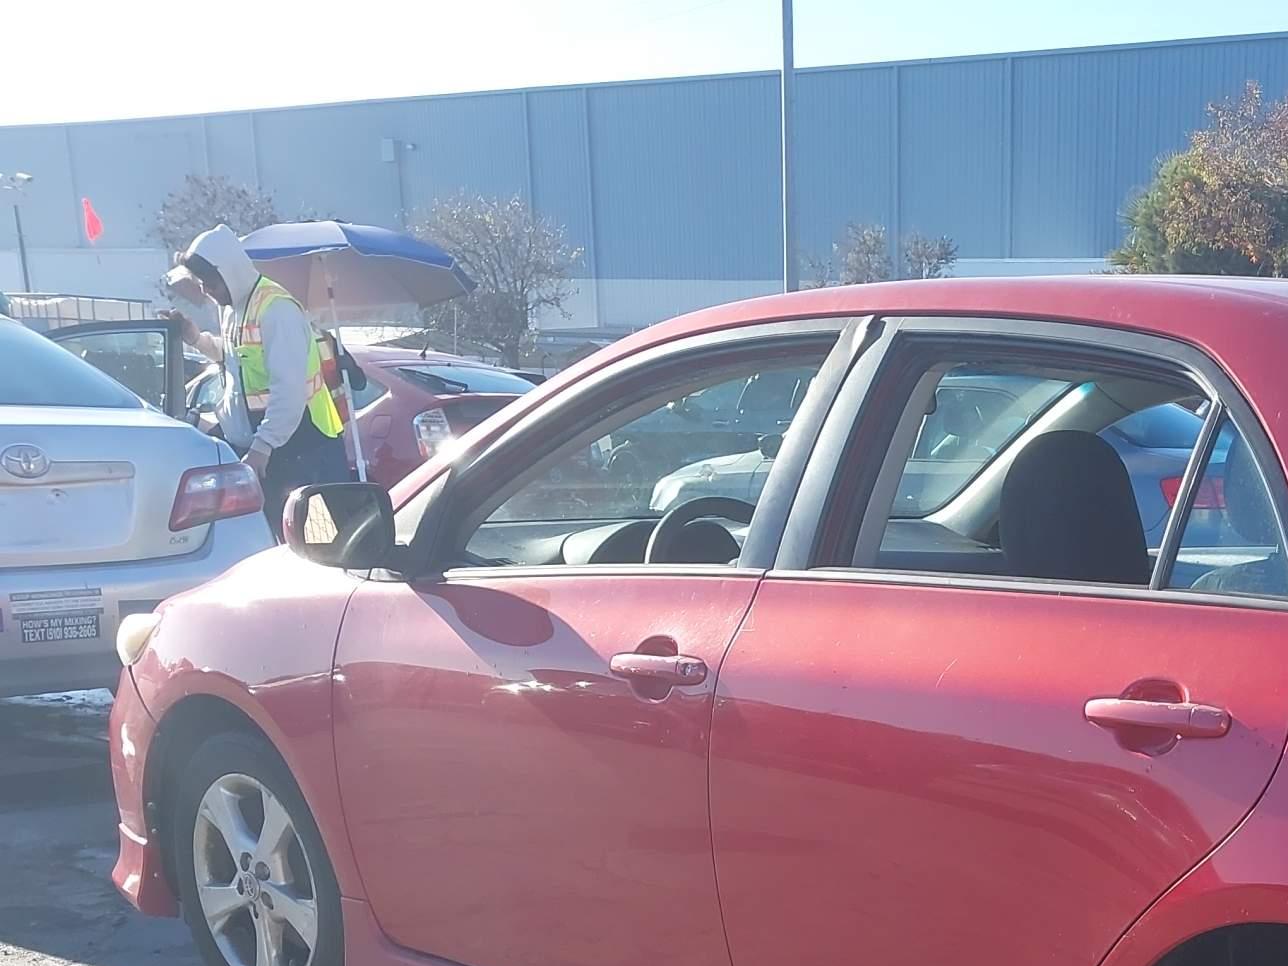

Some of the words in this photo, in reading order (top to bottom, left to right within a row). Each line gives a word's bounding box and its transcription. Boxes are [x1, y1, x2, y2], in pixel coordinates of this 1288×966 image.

[50, 617, 63, 627] MY
[23, 628, 45, 642] TEXT
[46, 626, 63, 640] (510)
